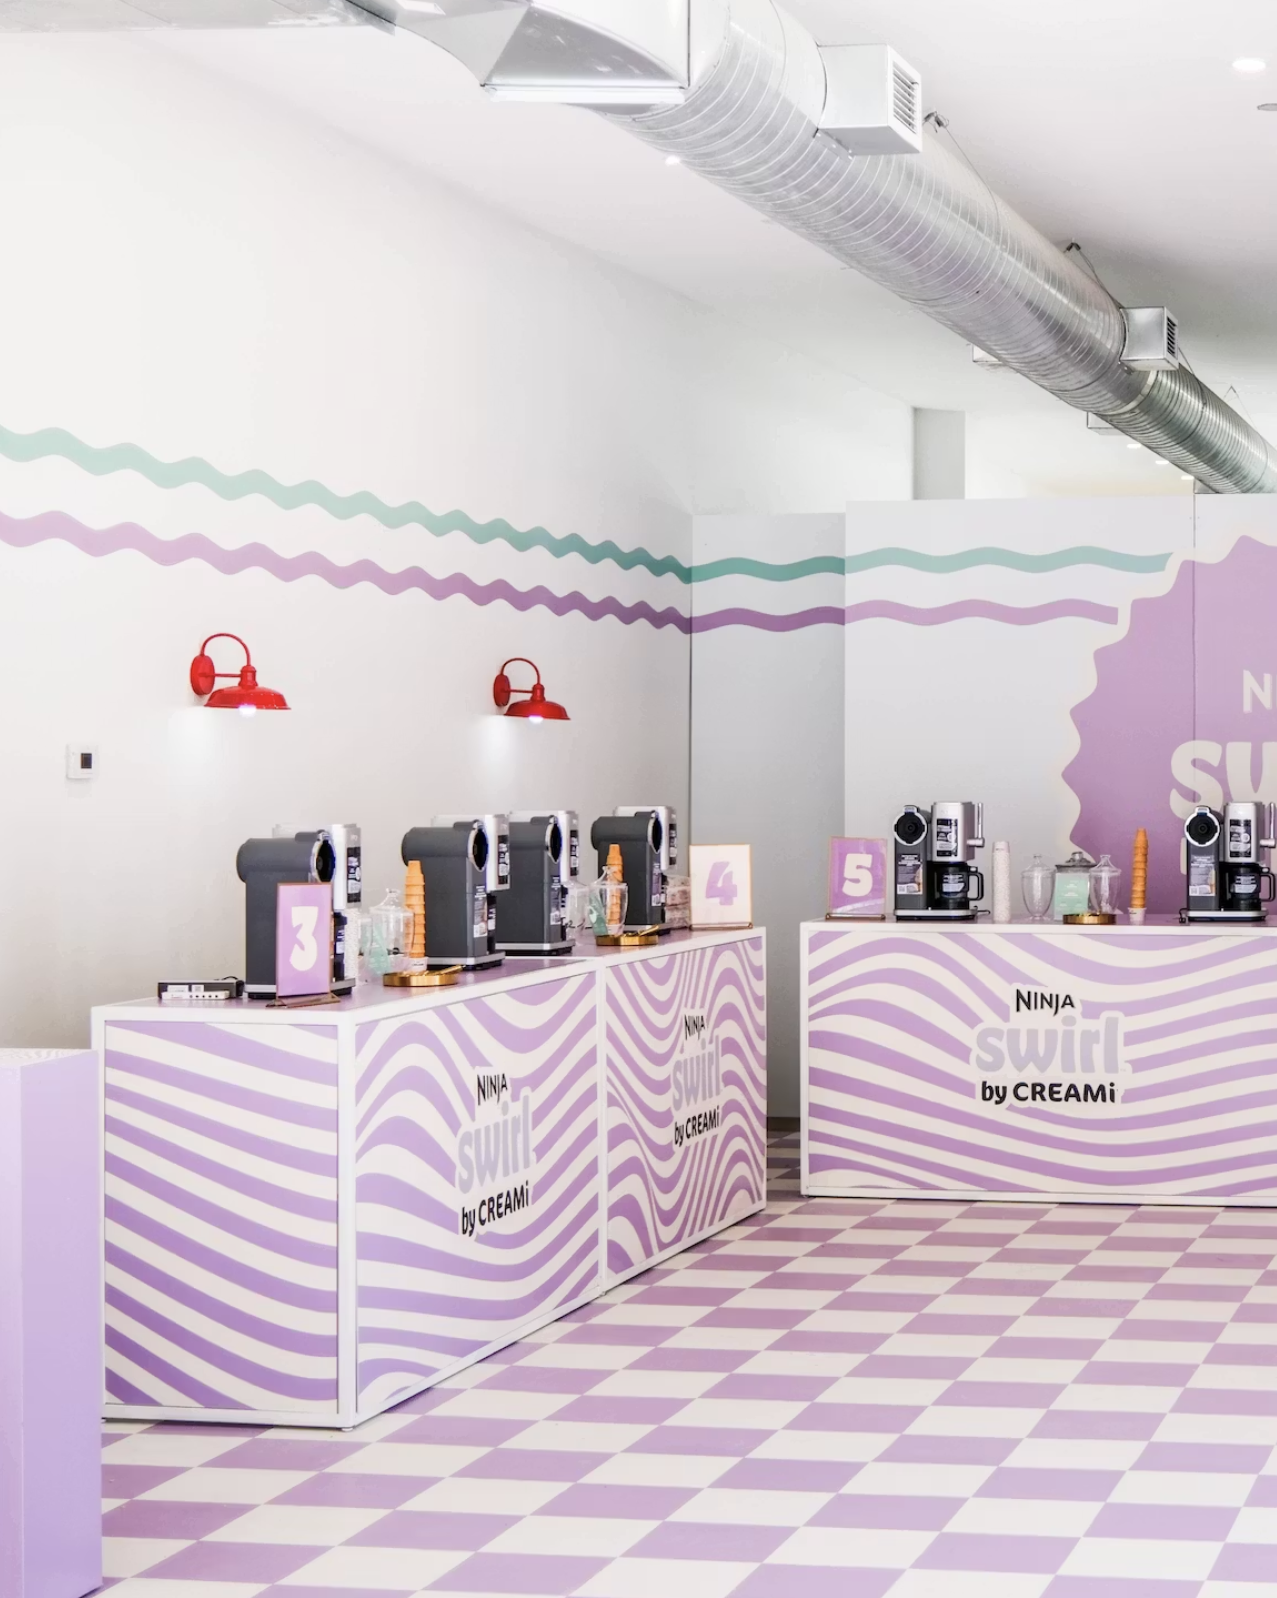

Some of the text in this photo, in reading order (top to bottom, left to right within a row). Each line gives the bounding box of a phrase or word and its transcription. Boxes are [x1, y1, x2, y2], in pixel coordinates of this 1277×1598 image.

[705, 861, 738, 906] 4
[841, 853, 873, 897] 5
[289, 906, 319, 972] 3
[1016, 988, 1076, 1017] NINJA
[684, 1014, 706, 1041] NINJA
[975, 1015, 1119, 1074] swirl
[477, 1073, 508, 1106] NINJA
[672, 1034, 720, 1111] swirl
[981, 1081, 1116, 1105] by CREAMi
[458, 1094, 531, 1194] swirl
[674, 1105, 719, 1147] by CREAMi
[462, 1180, 529, 1238] by CREAMi
